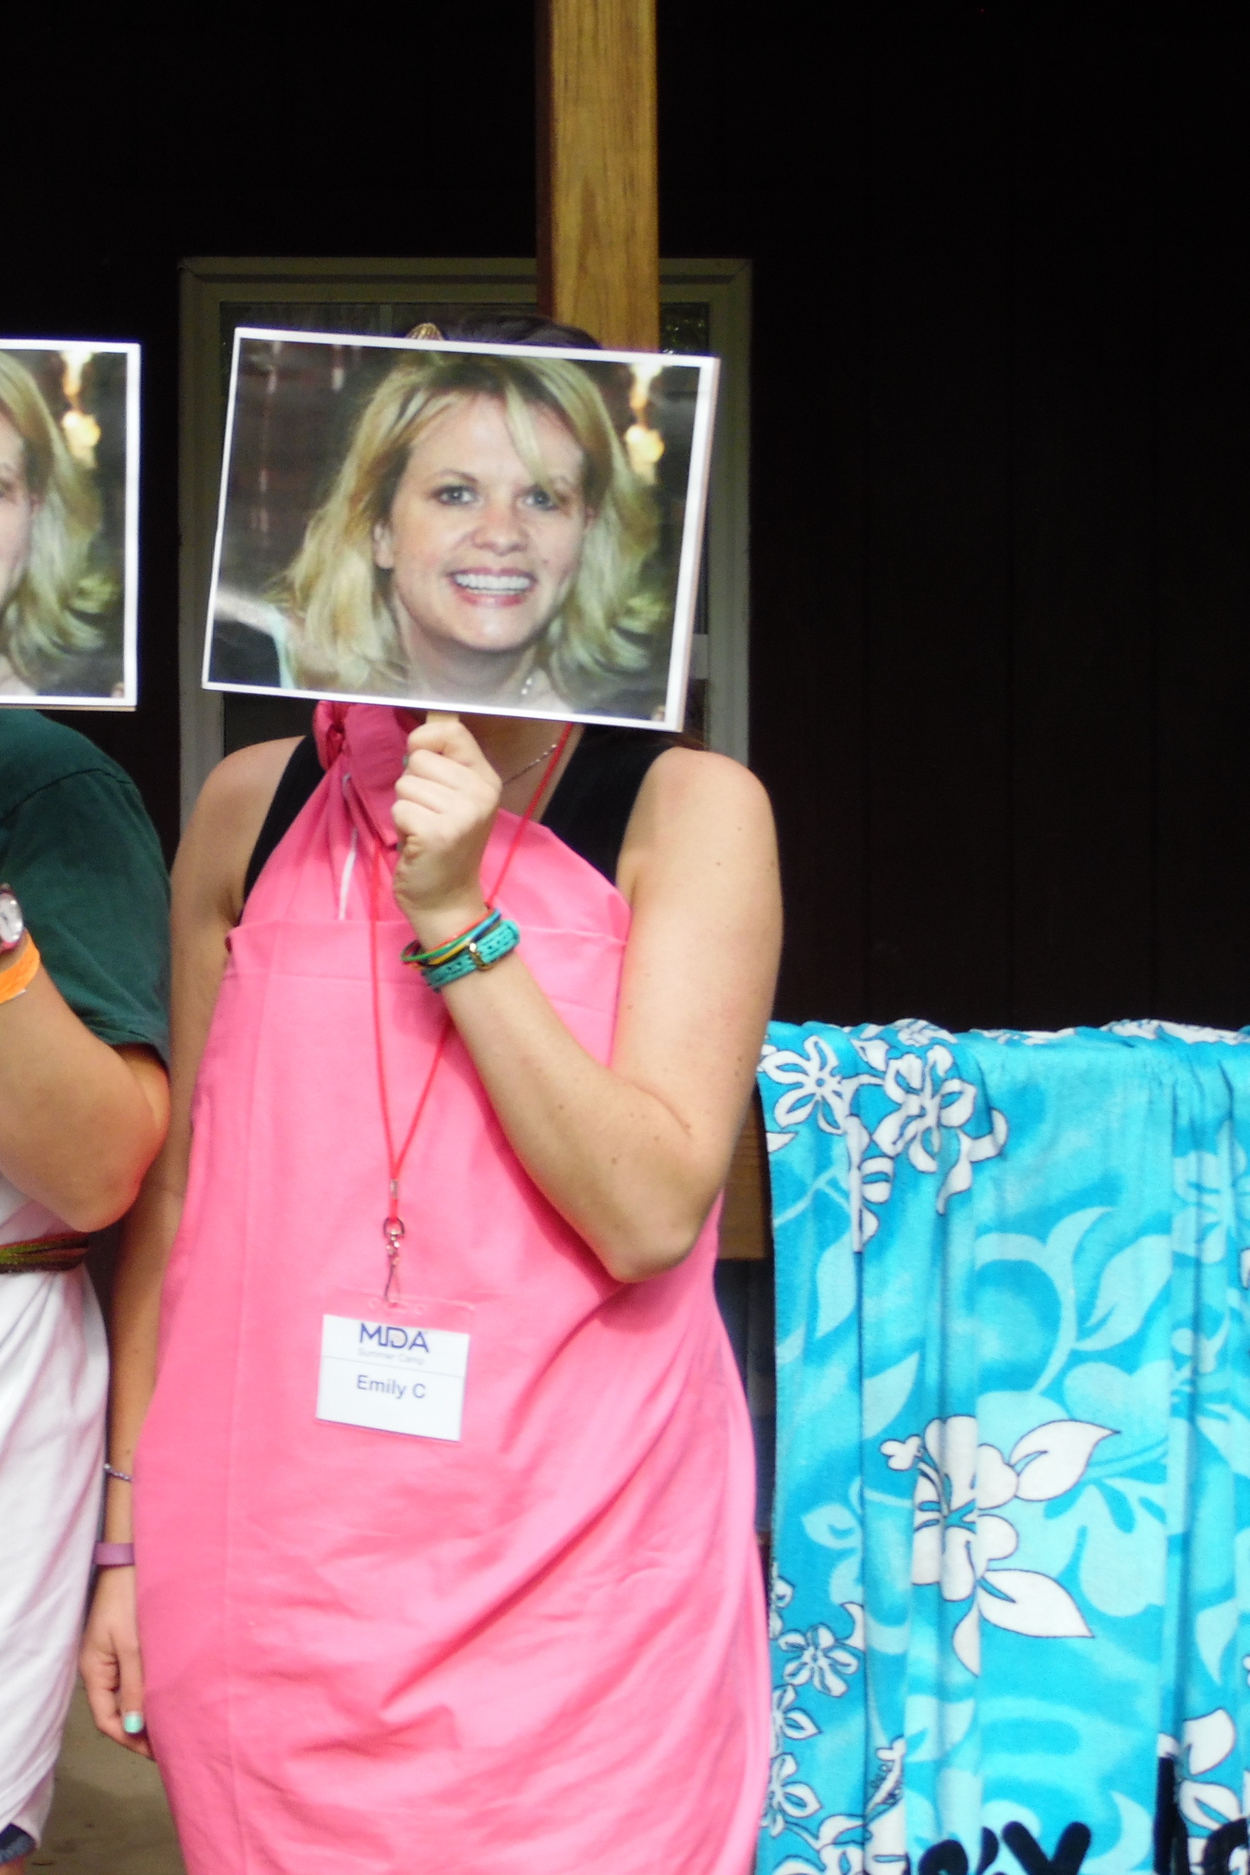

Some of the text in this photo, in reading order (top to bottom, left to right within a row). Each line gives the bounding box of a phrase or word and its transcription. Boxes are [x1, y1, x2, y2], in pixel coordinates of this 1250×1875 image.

[359, 1322, 430, 1353] MDA
[356, 1374, 426, 1400] Emily C
